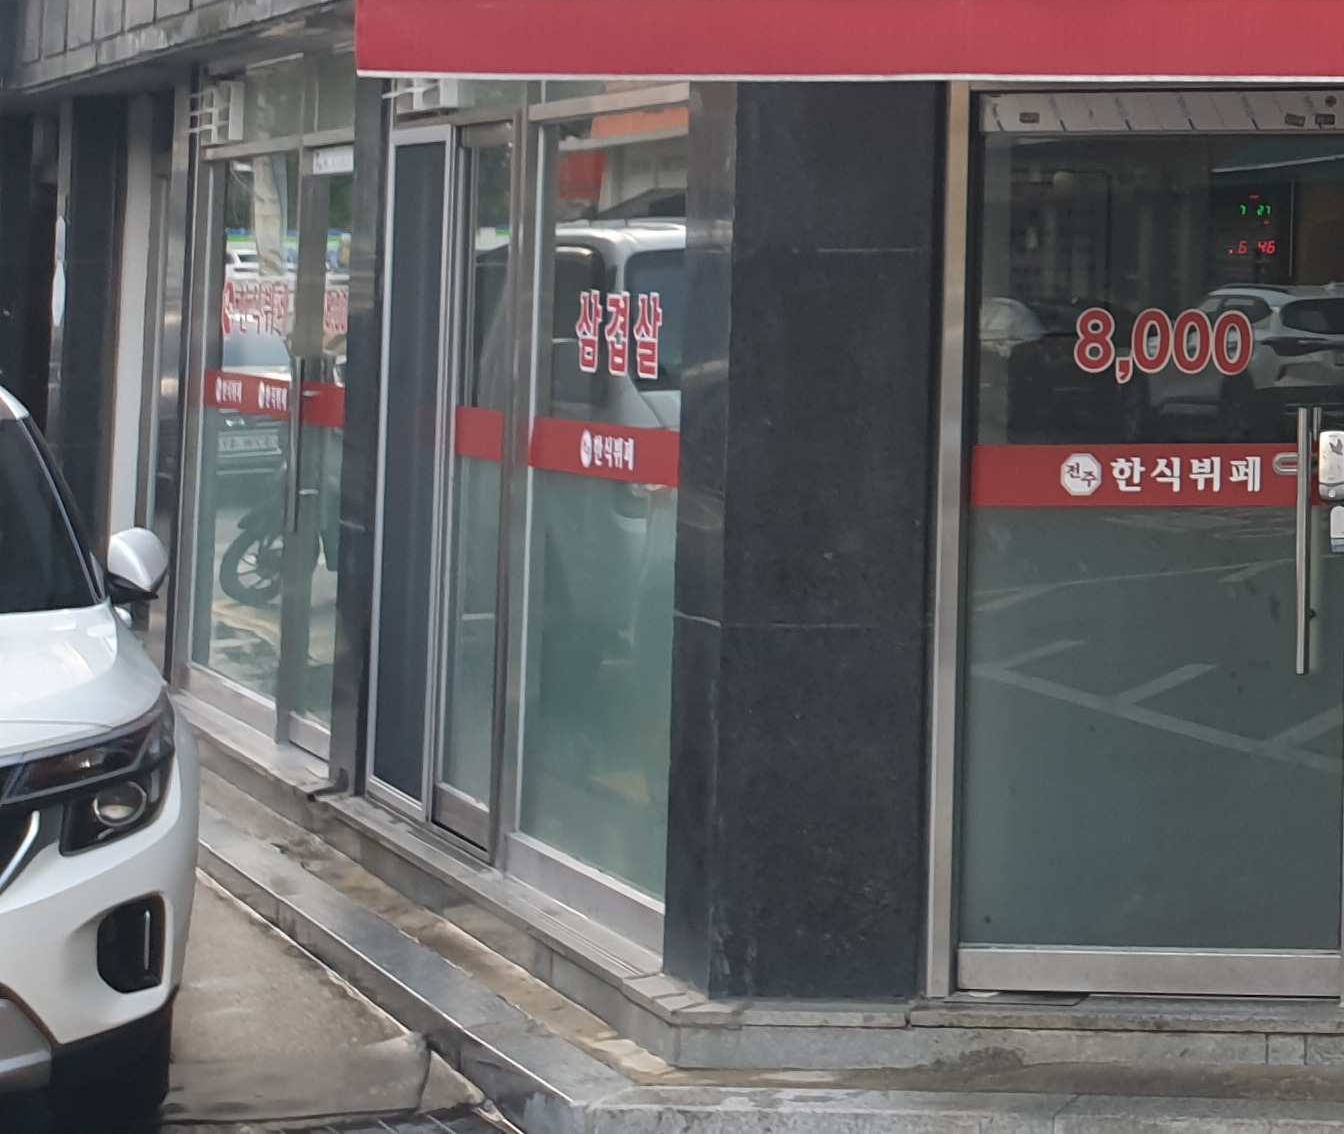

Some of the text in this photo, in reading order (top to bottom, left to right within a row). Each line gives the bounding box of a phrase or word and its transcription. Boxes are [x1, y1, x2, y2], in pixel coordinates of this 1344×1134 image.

[575, 289, 662, 379] 삼겹살
[1074, 307, 1253, 384] 8,000
[1066, 457, 1262, 492] 전주 한식뷔페
